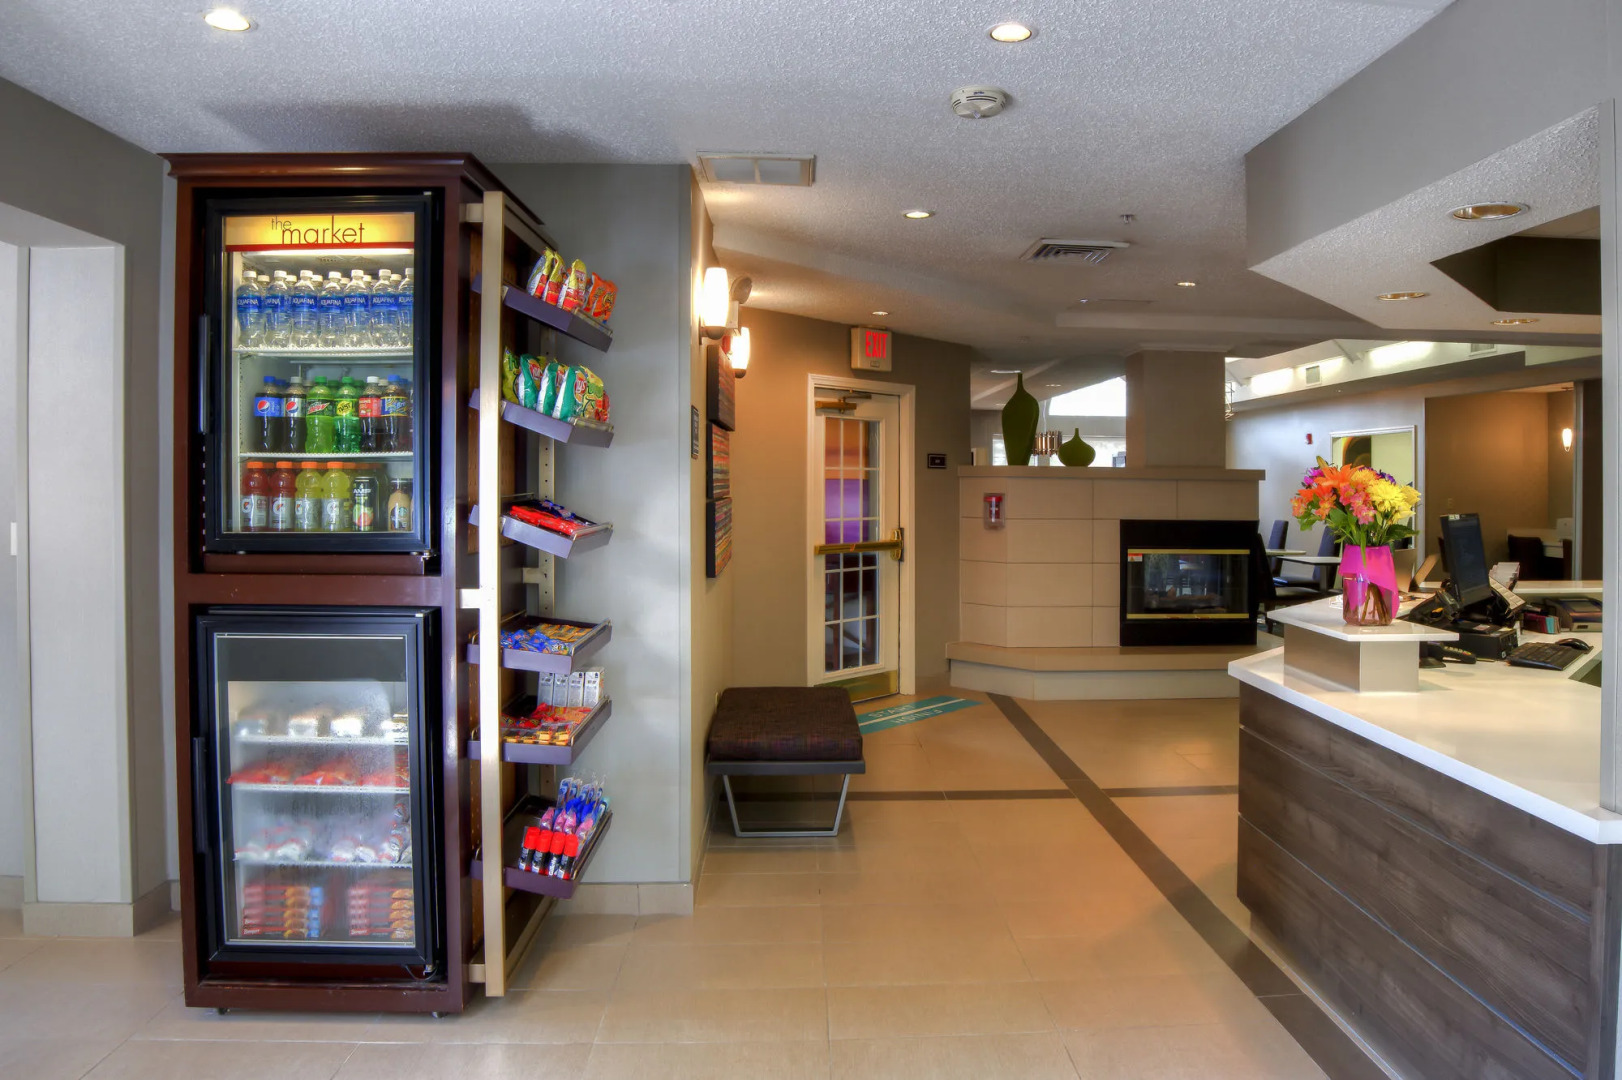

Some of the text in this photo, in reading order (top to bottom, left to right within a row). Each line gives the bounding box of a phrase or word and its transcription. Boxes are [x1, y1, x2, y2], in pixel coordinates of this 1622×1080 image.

[271, 216, 292, 231] the
[282, 214, 365, 244] market
[865, 330, 888, 359] EXIT
